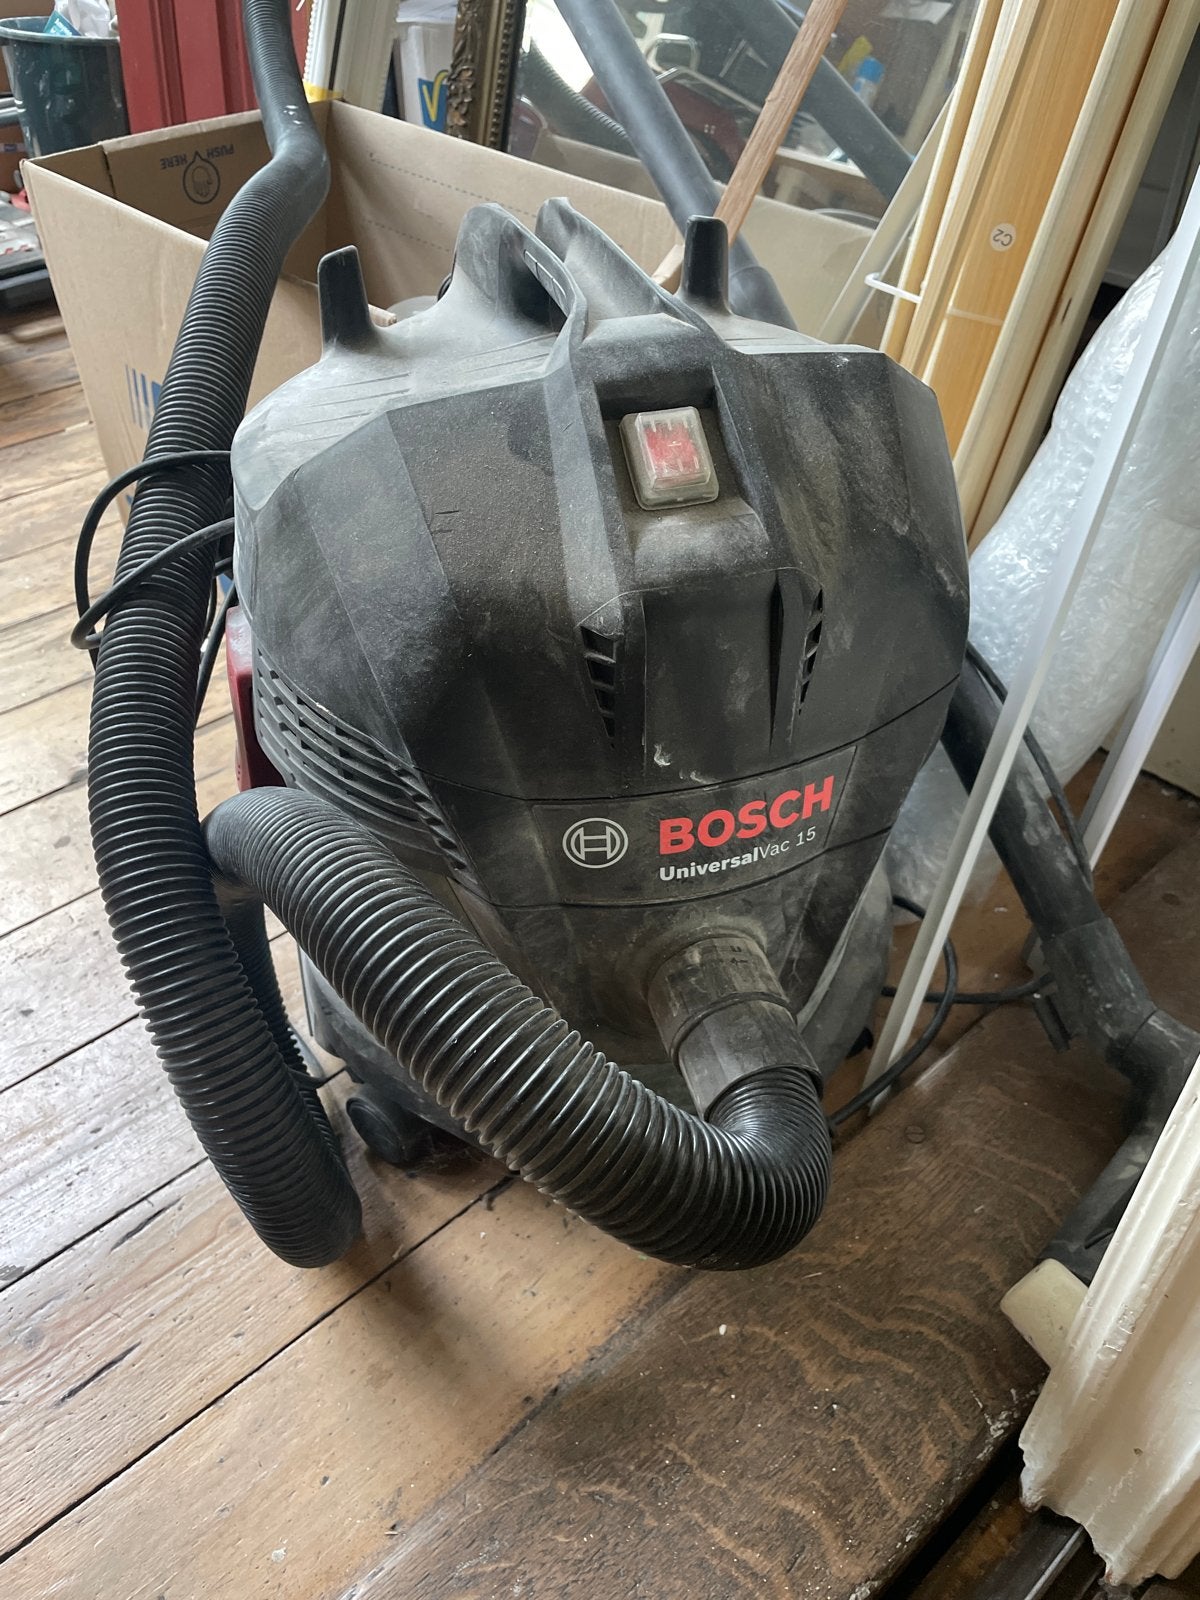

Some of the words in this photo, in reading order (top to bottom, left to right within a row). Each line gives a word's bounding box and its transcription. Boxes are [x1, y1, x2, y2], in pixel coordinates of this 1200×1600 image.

[206, 144, 235, 159] PUSH
[160, 153, 188, 170] HERE
[992, 228, 1013, 247] C2
[659, 775, 835, 855] BOSCH
[659, 839, 790, 881] UniversalVac
[795, 826, 817, 847] 15
